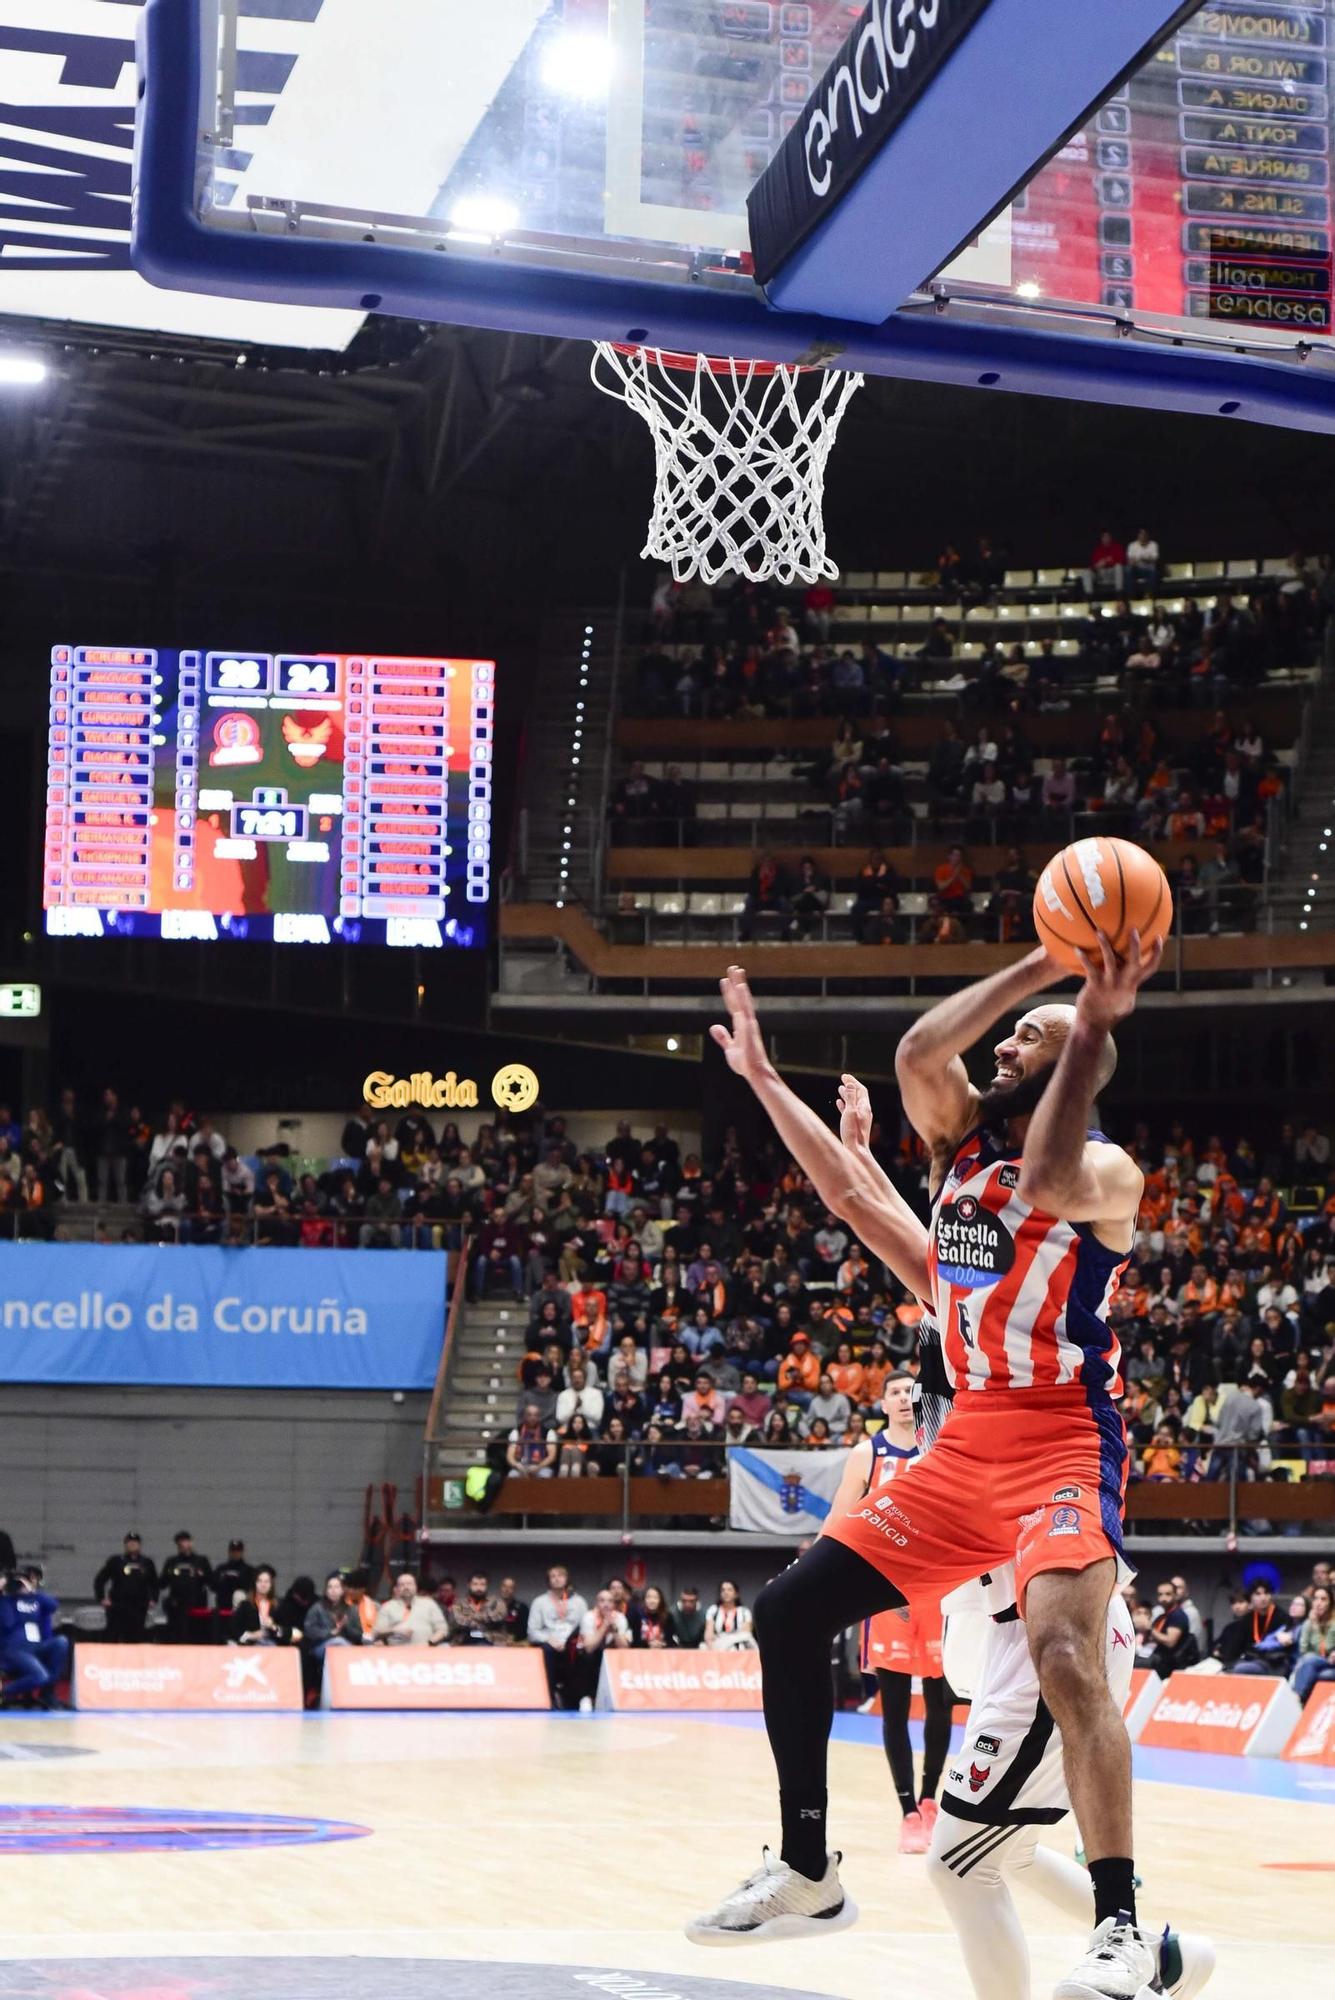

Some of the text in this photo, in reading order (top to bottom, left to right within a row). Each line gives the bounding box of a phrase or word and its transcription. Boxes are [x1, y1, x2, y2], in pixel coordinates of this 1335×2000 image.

[1216, 261, 1266, 291] liga
[1216, 293, 1327, 326] endesa
[363, 1071, 479, 1109] Galicia
[937, 1217, 998, 1247] Estrella
[938, 1238, 995, 1269] Galicia
[0, 1291, 367, 1335] ncello da Coruña
[1055, 1491, 1074, 1500] acb
[846, 1508, 909, 1547] galicia
[702, 1669, 763, 1691] Galici
[977, 1740, 994, 1751] acb
